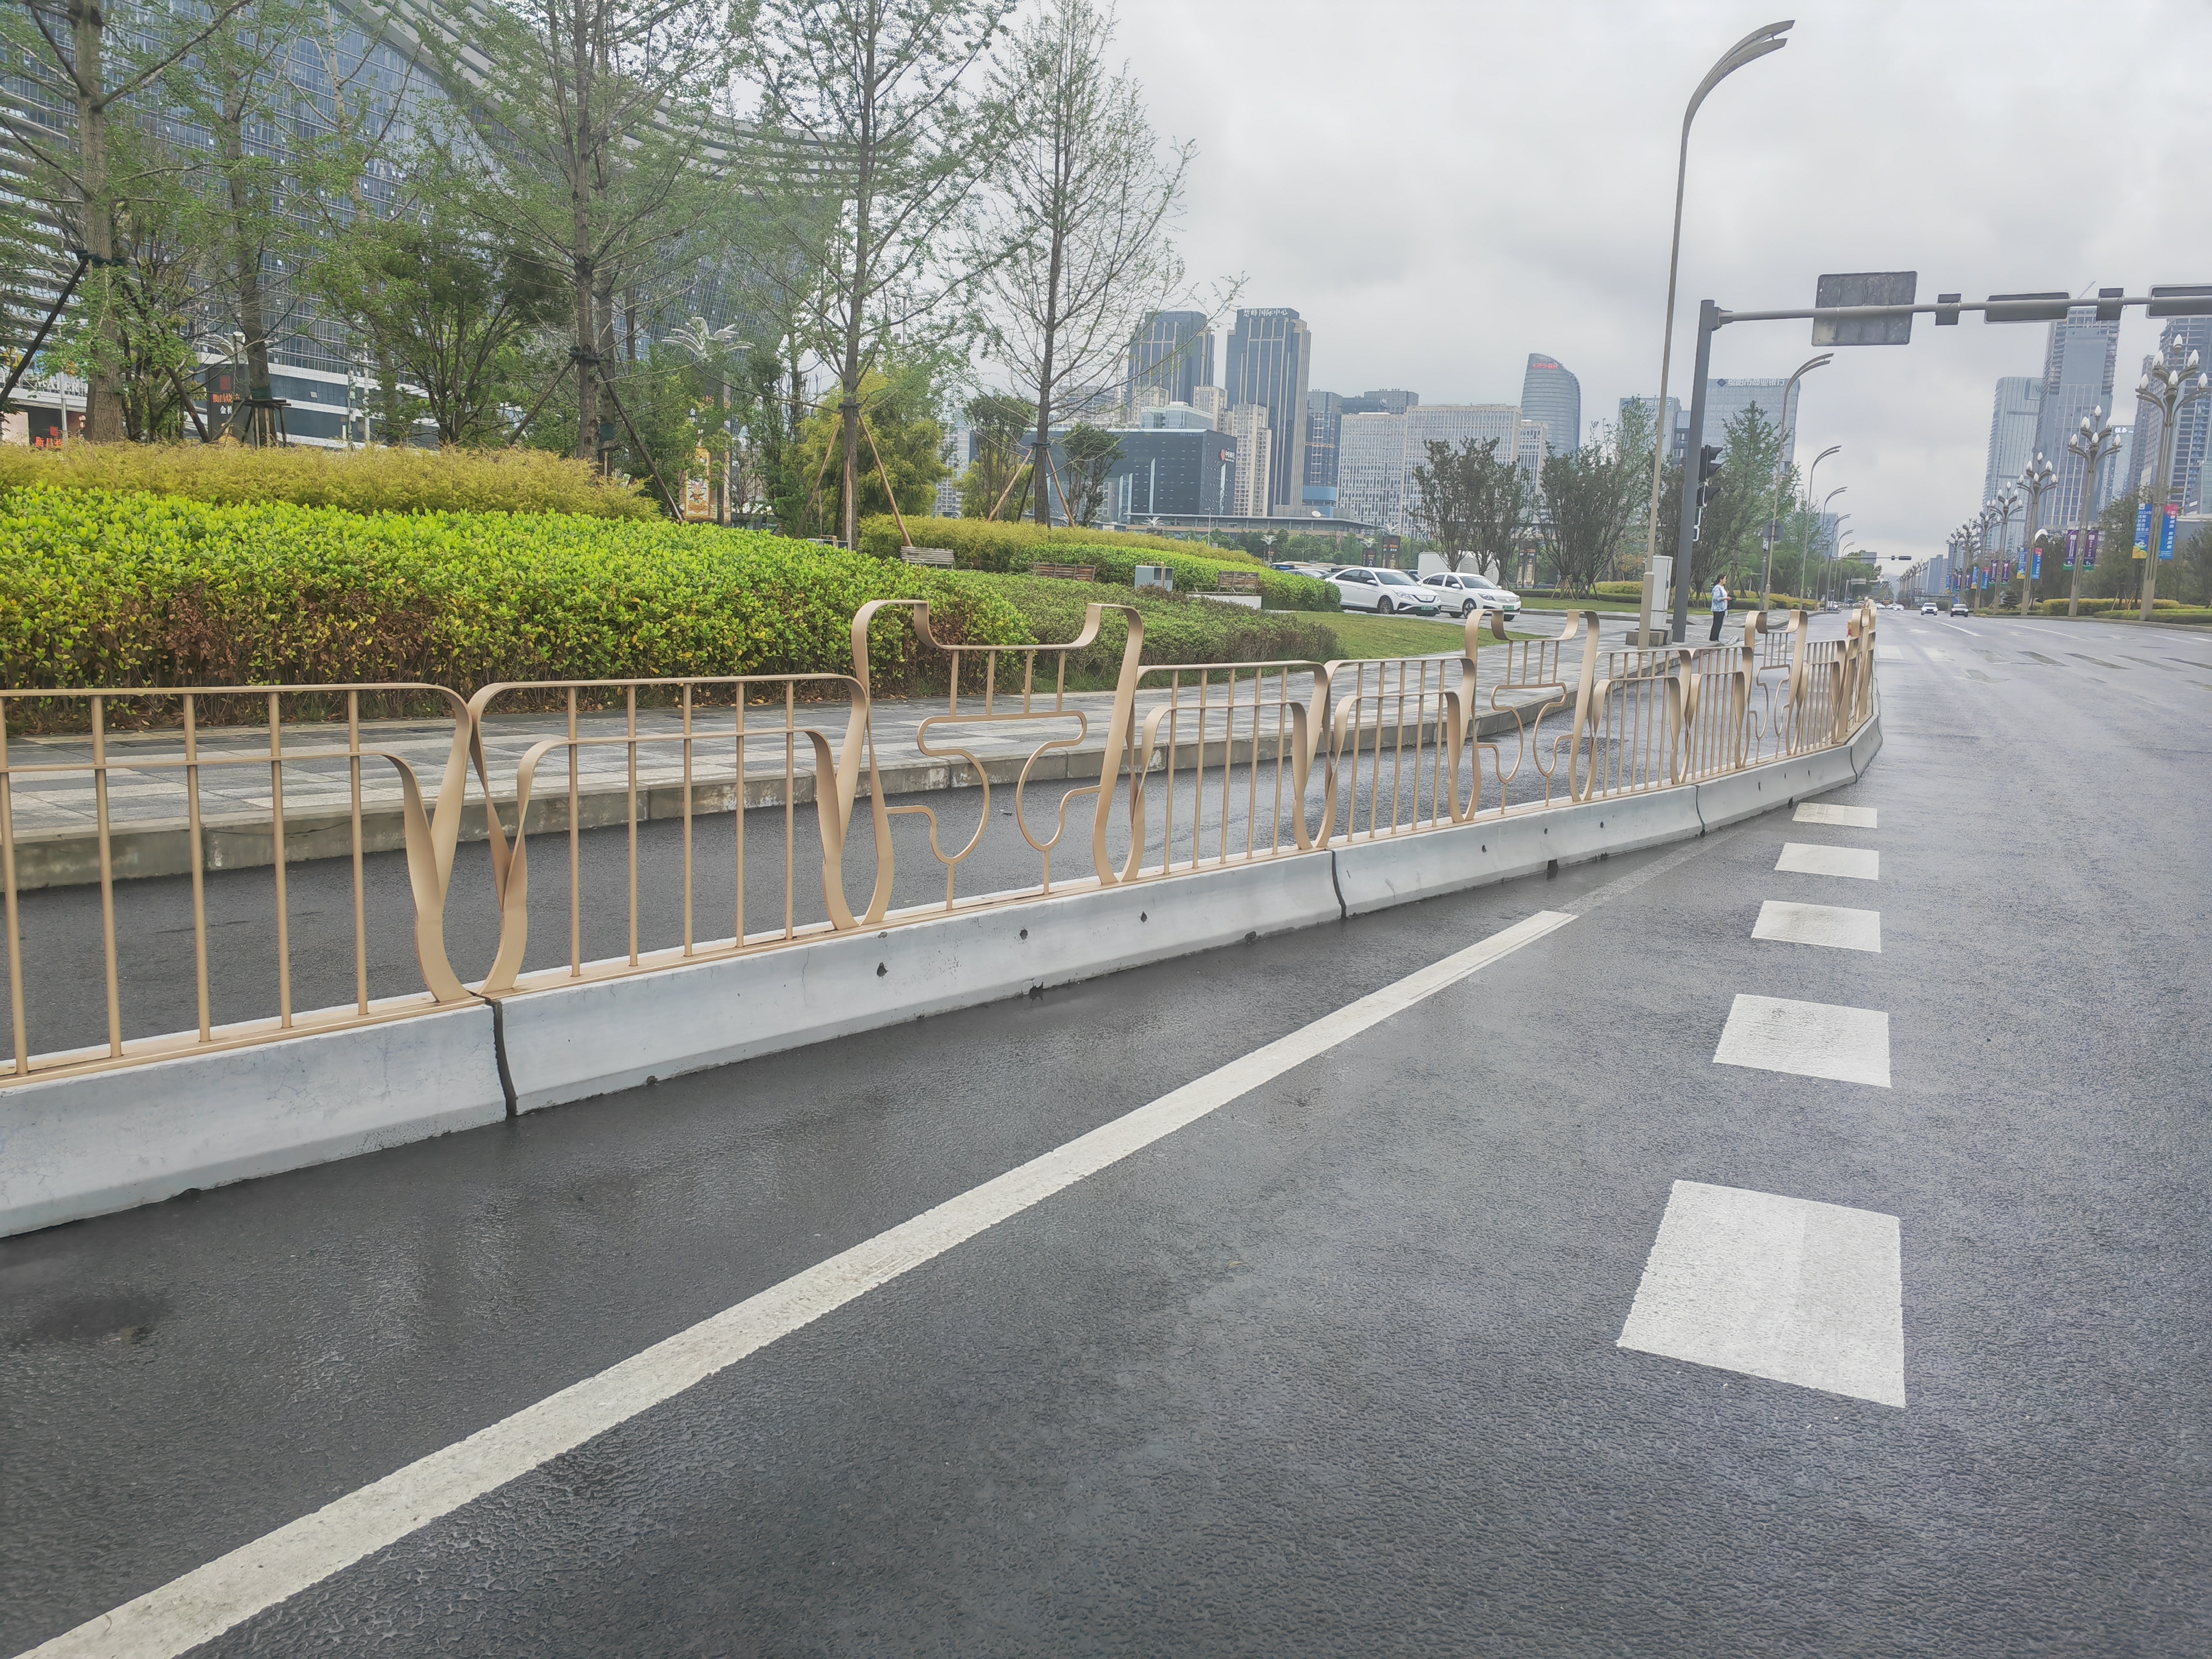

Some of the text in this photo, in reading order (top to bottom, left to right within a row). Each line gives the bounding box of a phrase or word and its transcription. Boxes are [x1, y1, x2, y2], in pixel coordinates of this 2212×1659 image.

[1728, 378, 1785, 386] 绵阳市商业银行
